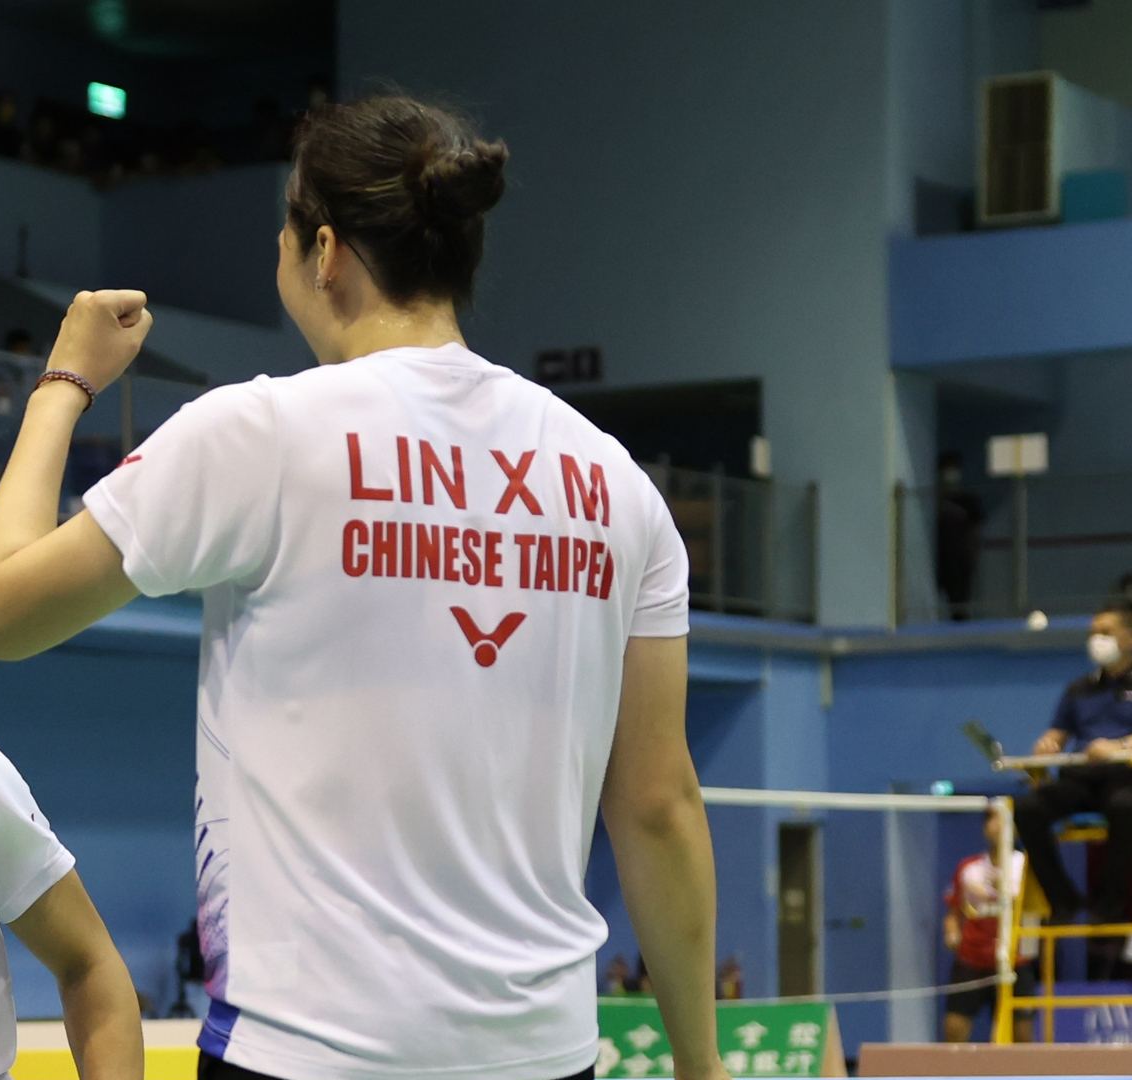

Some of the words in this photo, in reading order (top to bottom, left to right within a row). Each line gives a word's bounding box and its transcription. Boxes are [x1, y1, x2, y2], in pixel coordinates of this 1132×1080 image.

[345, 432, 467, 510] LIN
[489, 449, 544, 516] X
[559, 453, 610, 527] M
[342, 519, 503, 588] CHINESE
[514, 533, 614, 600] TAIPEI
